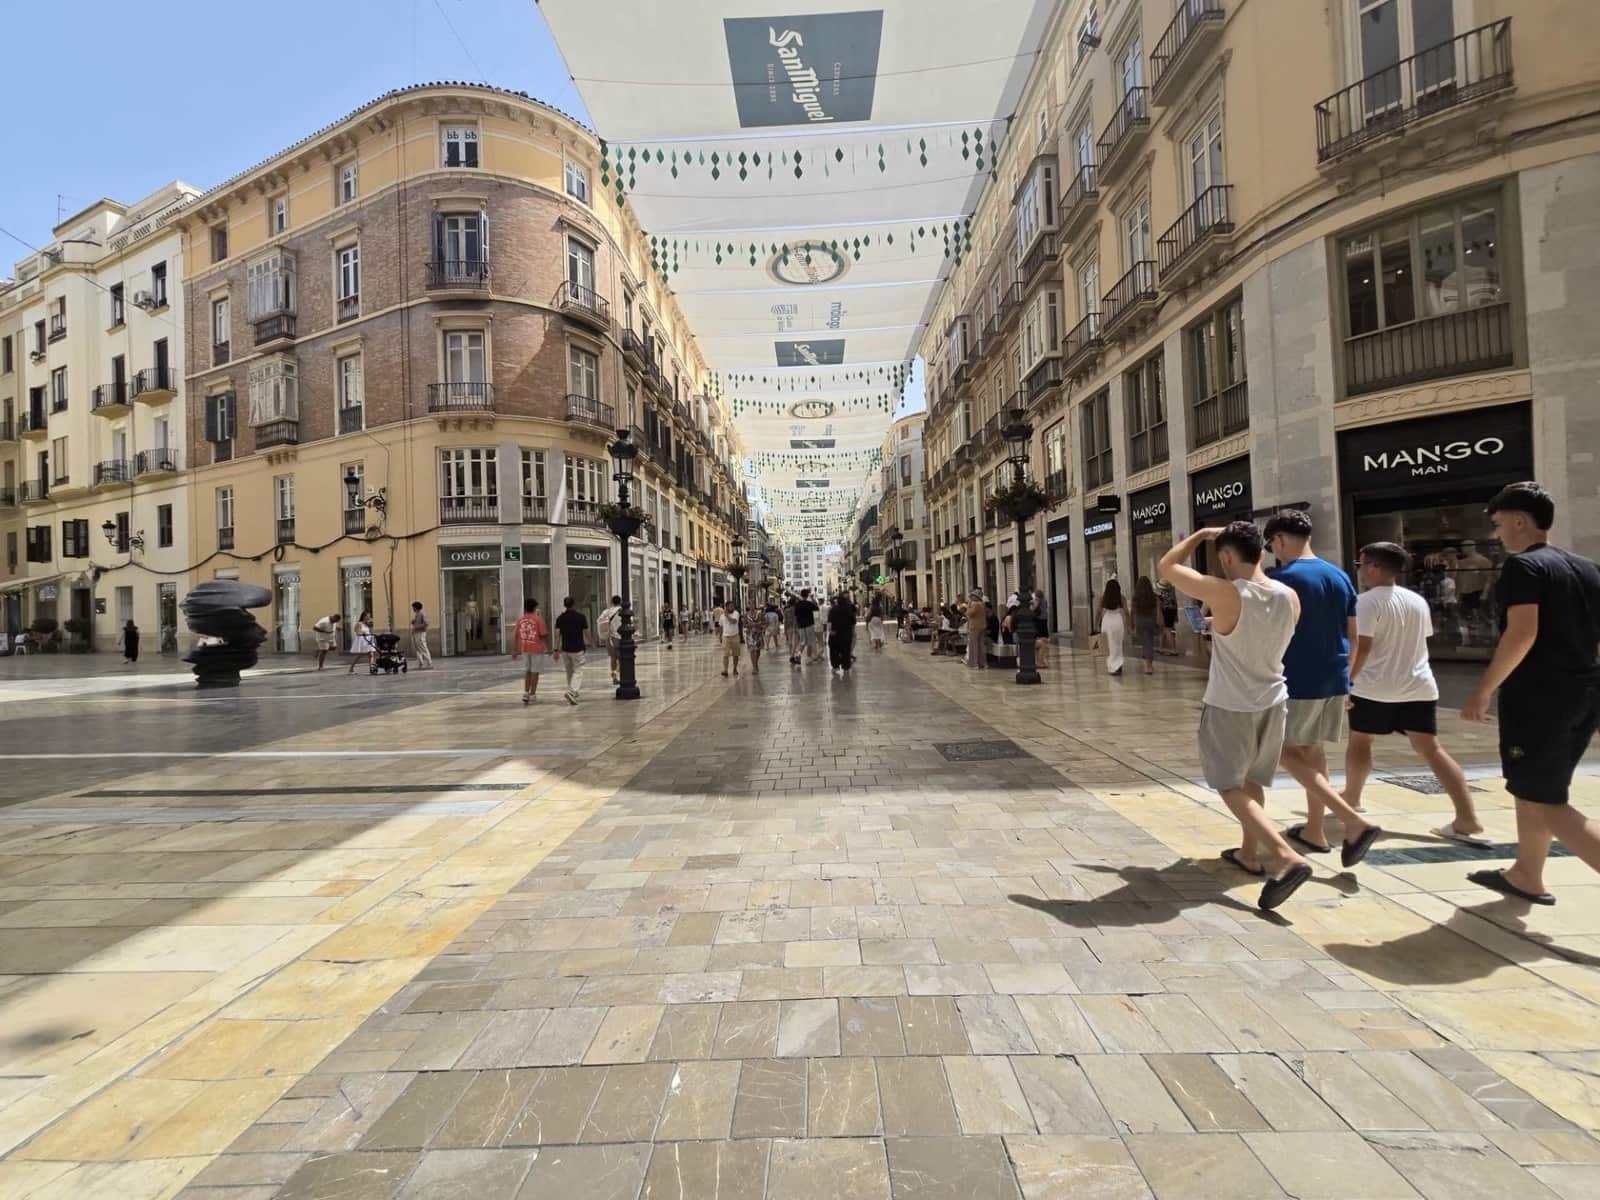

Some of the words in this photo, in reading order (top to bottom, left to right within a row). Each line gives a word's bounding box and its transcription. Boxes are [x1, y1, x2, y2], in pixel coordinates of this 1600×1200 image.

[1363, 437, 1504, 472] MANGO
[1411, 464, 1449, 476] MAN
[1195, 481, 1243, 506] MANGO
[1132, 502, 1166, 520] MANGO
[1212, 501, 1226, 510] MAN
[451, 551, 490, 561] OYSHO
[573, 551, 602, 561] OYSHO
